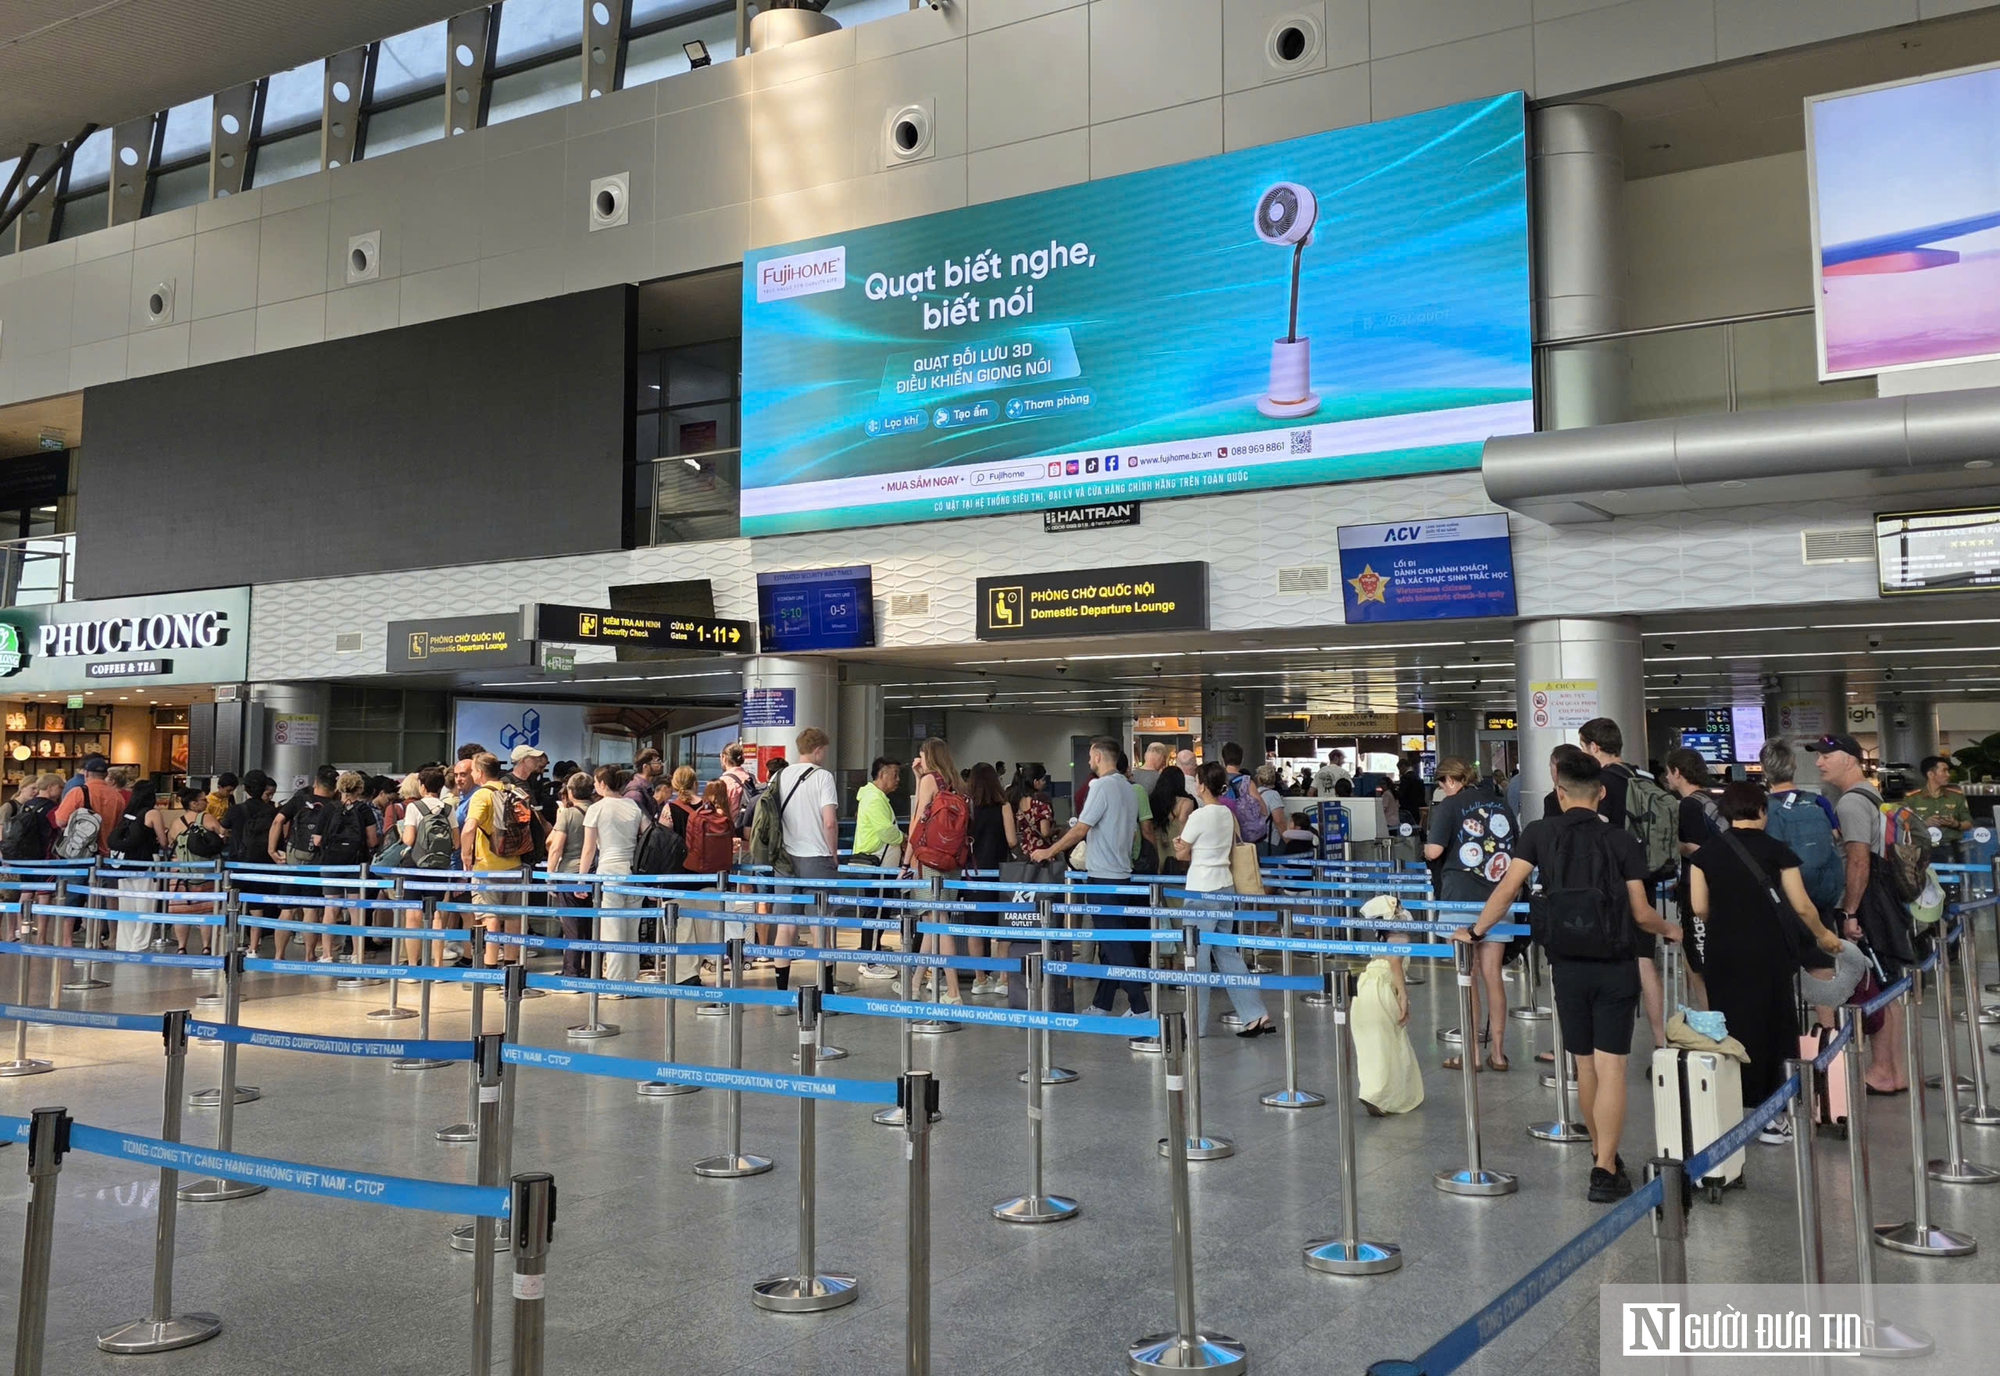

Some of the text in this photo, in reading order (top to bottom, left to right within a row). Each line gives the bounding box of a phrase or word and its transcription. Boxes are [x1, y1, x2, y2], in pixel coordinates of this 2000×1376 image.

[865, 240, 1096, 301] Quạt biết nghe,
[923, 287, 1033, 330] biết nói
[914, 342, 1032, 373] QUẠT ĐỐI LƯU 3D
[896, 358, 1052, 394] ĐIỀU KHIỂN GIỌNG NÓI
[1024, 393, 1090, 410] Thơm phòng
[954, 405, 989, 421] Tạo ẩm
[884, 414, 919, 431] Lọc khí
[1231, 441, 1285, 456] 088 969 8861
[1140, 450, 1213, 466] www.fujihome.biz.vn
[887, 475, 959, 492] MUA SẮM NGAY
[989, 470, 1025, 482] Fujihome
[934, 502, 944, 512] CÓ
[962, 499, 973, 511] TẠI
[975, 498, 985, 510] HỆ
[1012, 492, 1029, 504] SIÊU
[1075, 486, 1085, 499] VÀ
[1105, 482, 1125, 495] HÀNG
[1128, 479, 1152, 493] CHÍNH
[1179, 474, 1200, 488] TRÊN
[1203, 473, 1224, 486] TOÀN
[1227, 470, 1249, 484] QUỐC
[1384, 526, 1421, 543] ACV
[1393, 559, 1406, 568] LỐI
[1394, 568, 1416, 577] DÀNH
[1436, 565, 1459, 574] HÀNH
[1460, 563, 1488, 572] KHÁCH
[774, 573, 800, 581] ESTIMATED
[801, 571, 823, 580] SECURITY
[824, 570, 837, 578] WAIT
[1408, 576, 1423, 584] XÁC
[1425, 575, 1446, 584] THỰC
[1447, 574, 1468, 582] SINH
[1468, 571, 1490, 580] TRẮC
[1491, 571, 1509, 580] HỌC
[1031, 581, 1155, 602] PHÒNG CHỜ QUỐC NỘI
[1396, 585, 1440, 594] Vietnamese
[1416, 593, 1452, 602] biometric
[1453, 591, 1487, 600] check-in
[780, 607, 802, 619] 5-10
[830, 604, 846, 616] 0-5
[1031, 601, 1175, 619] Domestic Departure Lounge
[602, 615, 661, 629] KIỂM TRA AN NINH
[670, 621, 684, 631] CỬA
[430, 631, 505, 645] PHÒNG CHỜ QUỐC NỘI
[602, 627, 649, 638] Security Check
[670, 632, 688, 641] Gates
[430, 642, 508, 653] Domestic Departure Lounge
[91, 661, 156, 675] COFFEE & TEA
[1106, 967, 1261, 987] AIRPORTS CORPORATION OF VIETNAM
[914, 1005, 925, 1014] TY
[1029, 1015, 1048, 1025] NAM
[1055, 1017, 1079, 1027] CTCP
[197, 1025, 218, 1037] CTCP
[250, 1032, 404, 1056] AIRPORTS CORPORATION OF VIETNAM
[523, 1052, 542, 1062] NAM
[547, 1054, 571, 1066] CTCP
[656, 1067, 836, 1095] AIRPORTS CORPORATION OF VIETNAM
[180, 1151, 192, 1164] TY
[321, 1175, 345, 1191] NAM
[354, 1179, 385, 1196] CTCP
